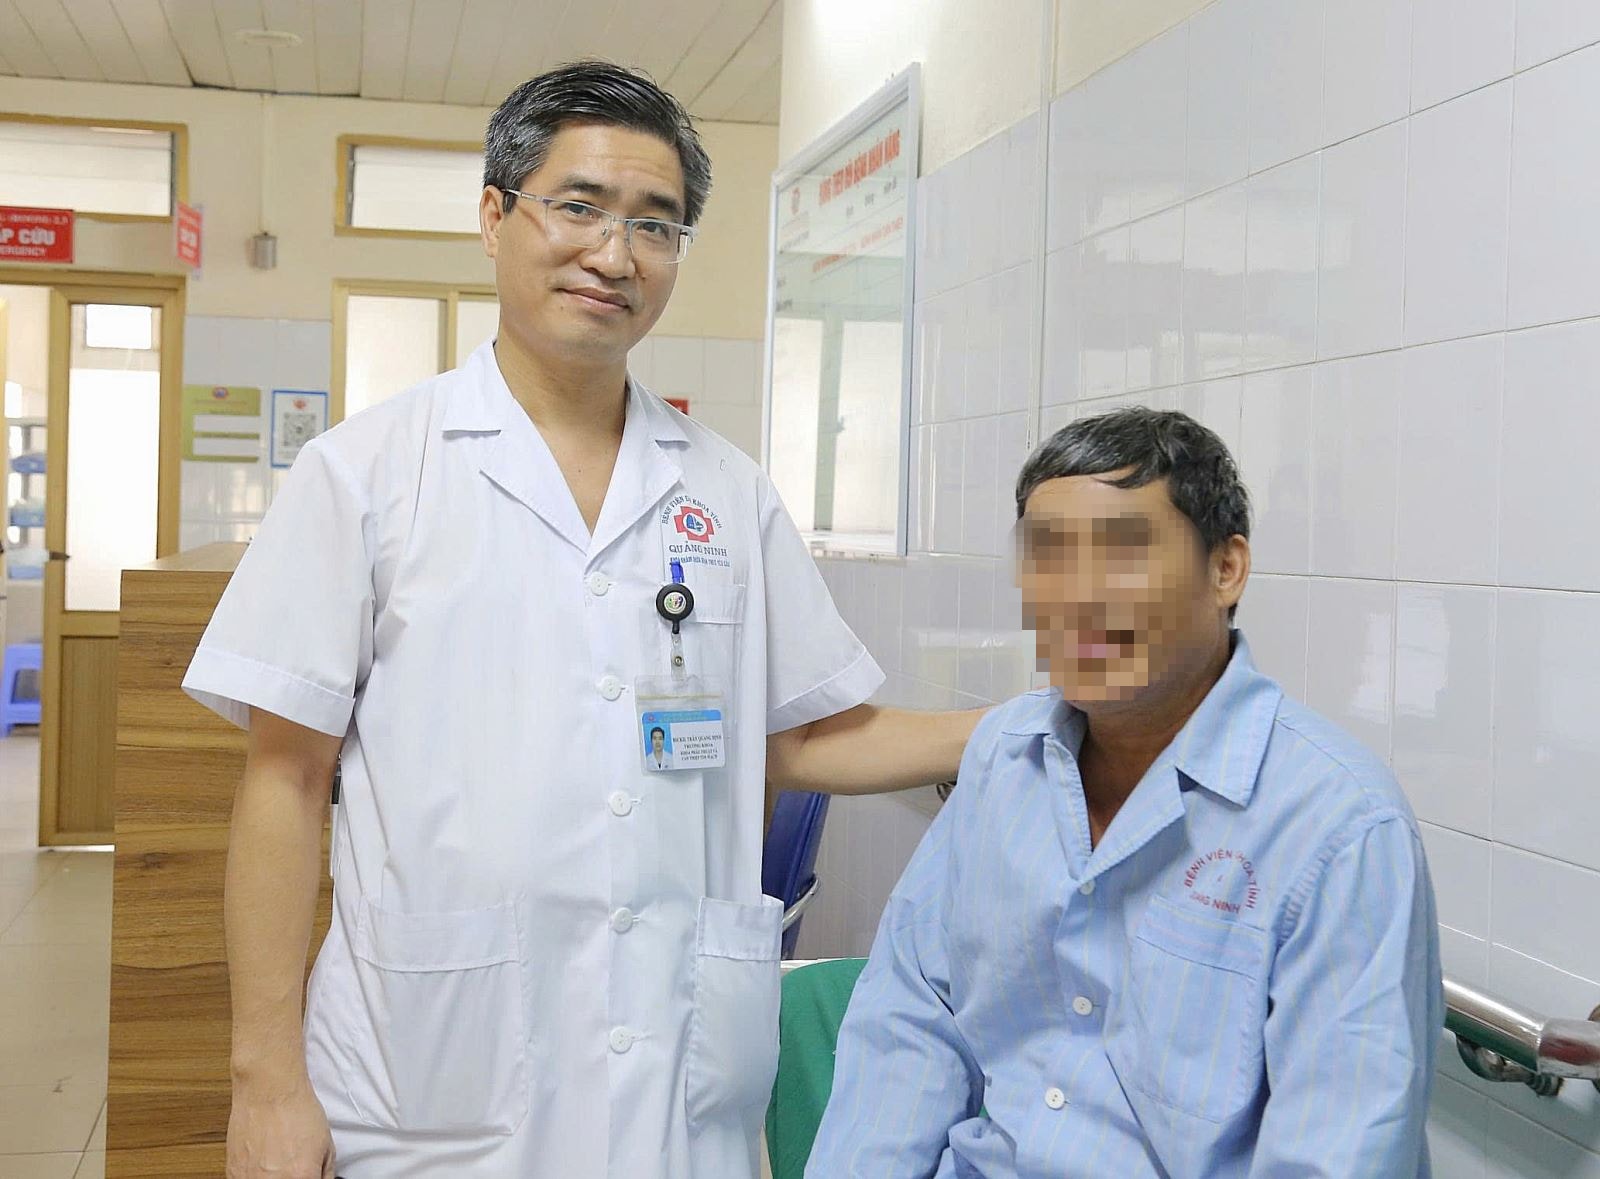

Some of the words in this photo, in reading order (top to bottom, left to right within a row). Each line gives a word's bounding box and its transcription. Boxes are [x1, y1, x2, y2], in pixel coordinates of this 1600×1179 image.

[18, 226, 56, 246] CỨU
[692, 498, 709, 513] KHOA
[668, 540, 703, 554] QUẢNG
[703, 547, 728, 557] NINH
[1206, 848, 1233, 861] VIỆN
[1212, 899, 1241, 914] NINH
